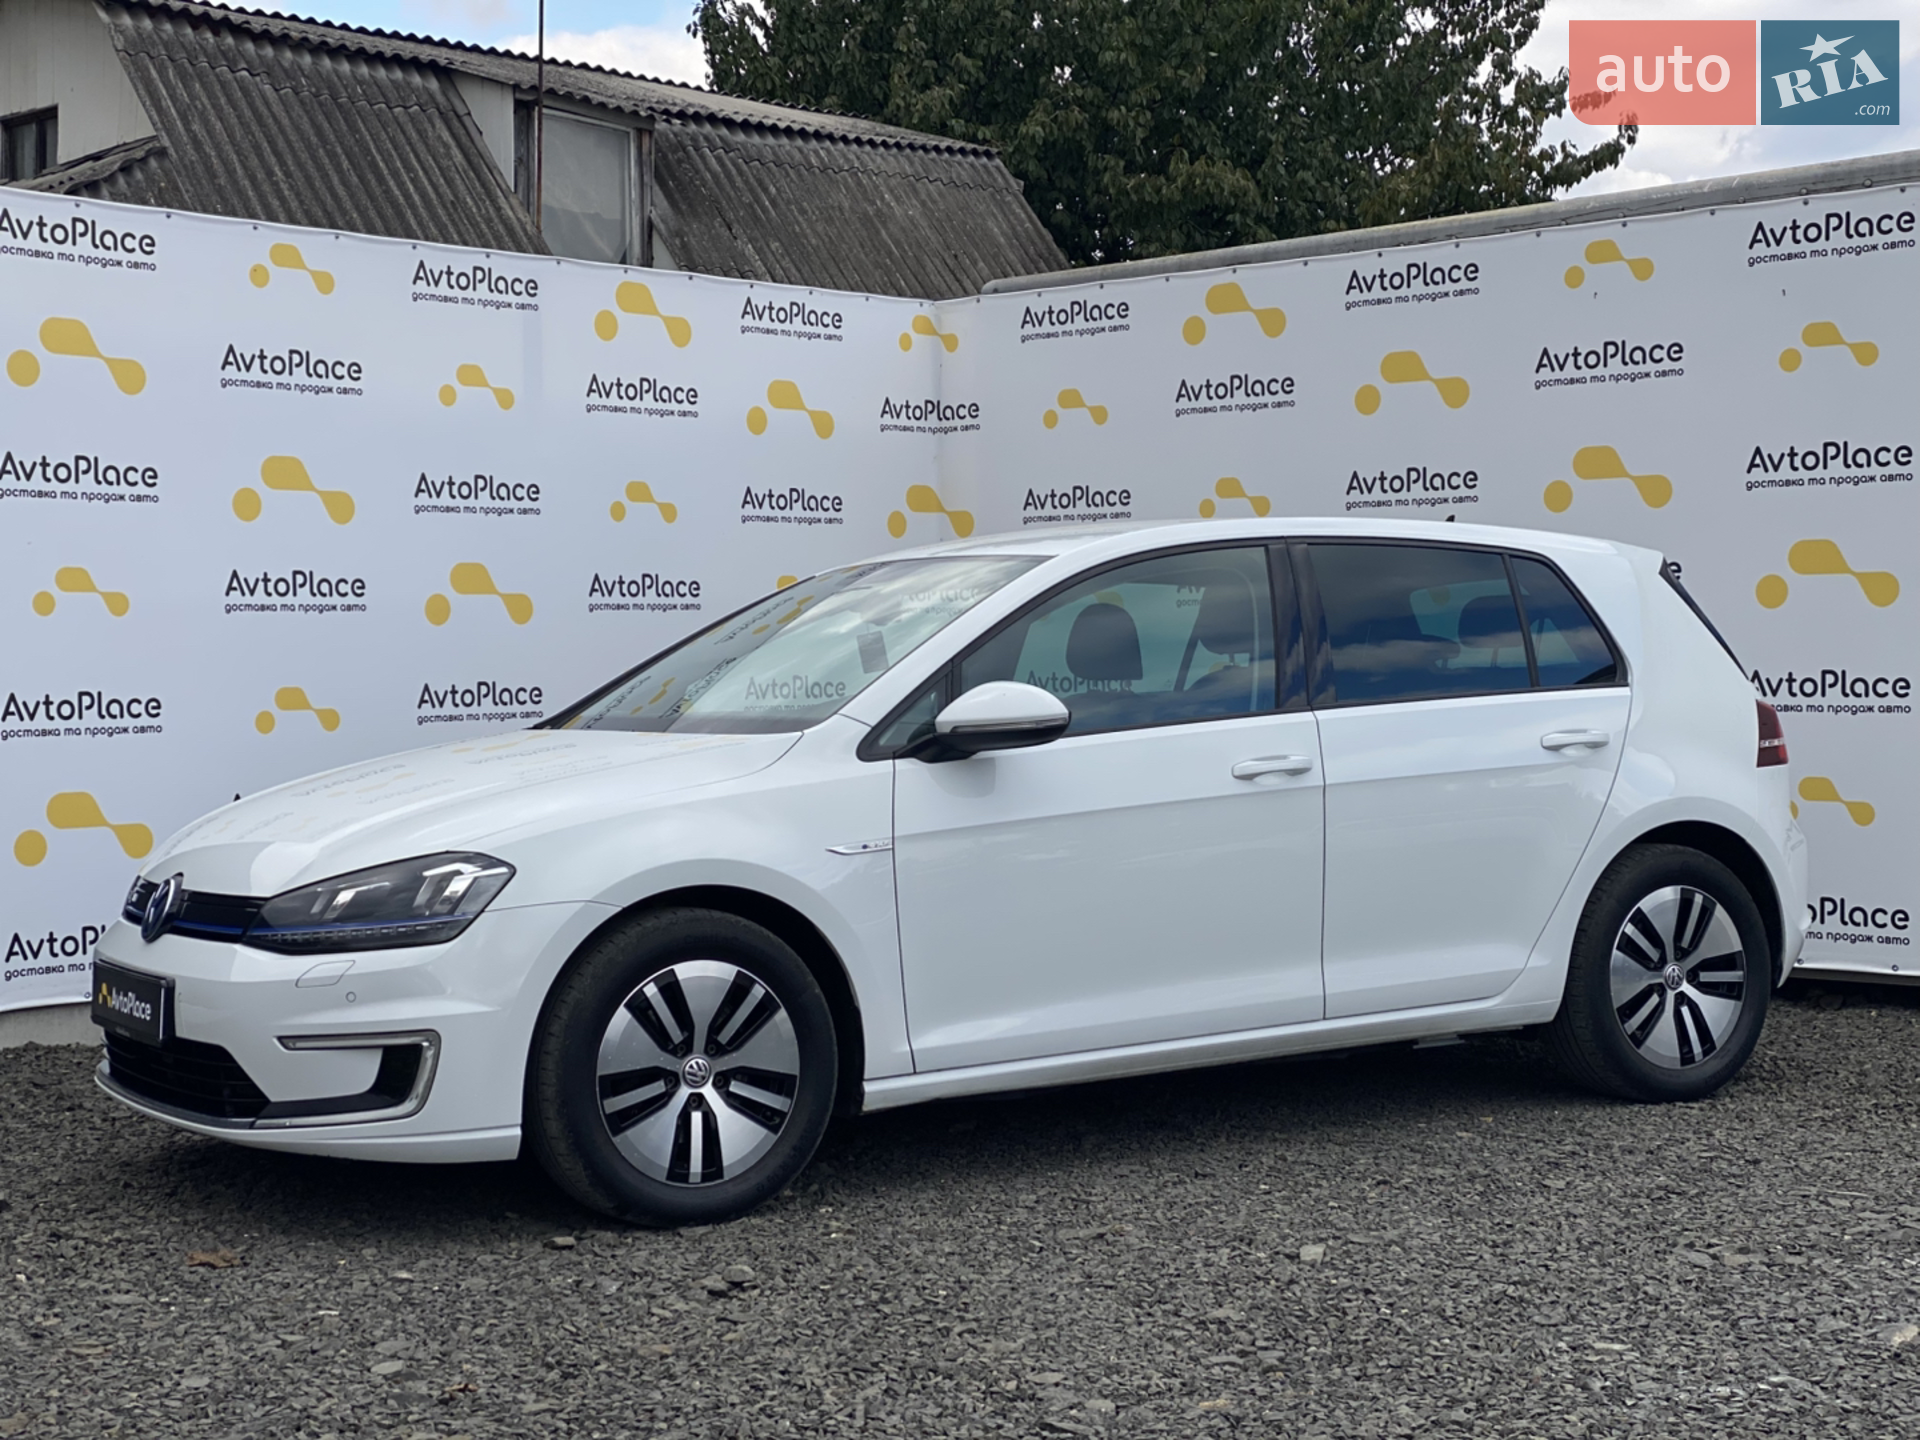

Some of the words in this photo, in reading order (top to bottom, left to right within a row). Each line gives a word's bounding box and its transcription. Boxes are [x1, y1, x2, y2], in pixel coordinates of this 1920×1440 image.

[0, 208, 156, 256] AvtoPlace
[1748, 211, 1915, 250] AvtoPlace
[0, 245, 54, 260] оставка
[57, 252, 75, 262] та
[78, 254, 123, 268] продаж
[126, 260, 156, 271] авто
[1748, 251, 1807, 267] доставка
[1810, 249, 1828, 258] та
[1831, 244, 1879, 258] продаж
[1882, 239, 1916, 250] авто
[412, 260, 538, 298] AvtoPlace
[1345, 261, 1479, 296] AvtoPlace
[412, 292, 459, 304] доставка
[461, 297, 475, 306] та
[477, 298, 512, 310] продаж
[515, 302, 539, 311] авто
[741, 296, 843, 330] AvtoPlace
[1345, 297, 1392, 311] доставка
[1412, 291, 1450, 303] продаж
[1452, 288, 1480, 297] авто
[1021, 300, 1130, 329] AvtoPlace
[221, 344, 362, 382] AvtoPlace
[1535, 340, 1684, 374] AvtoPlace
[220, 378, 274, 390] доставка
[276, 382, 292, 391] та
[294, 384, 334, 395] продаж
[336, 386, 363, 396] авто
[586, 373, 698, 406] AvtoPlace
[1176, 374, 1295, 403] AvtoPlace
[1534, 376, 1587, 390] доставка
[1590, 375, 1606, 383] та
[1609, 371, 1651, 384] продаж
[1654, 368, 1684, 378] авто
[880, 397, 980, 422] AvtoPlace
[0, 451, 158, 488] AvtoPlace
[1746, 440, 1913, 474] AvtoPlace
[414, 472, 540, 502] AvtoPlace
[1346, 466, 1478, 496] AvtoPlace
[1746, 478, 1804, 491] доставка
[1808, 477, 1826, 486] та
[1829, 475, 1876, 487] продаж
[1880, 473, 1913, 482] авто
[60, 491, 78, 500] та
[81, 492, 126, 504] продаж
[128, 494, 159, 503] авто
[414, 505, 461, 515] доставка
[463, 506, 477, 514] та
[479, 506, 514, 516] продаж
[741, 486, 843, 512] AvtoPlace
[1023, 485, 1131, 511] AvtoPlace
[1345, 500, 1392, 511] доставка
[1412, 497, 1449, 508] продаж
[1452, 495, 1478, 504] авто
[225, 569, 366, 598] AvtoPlace
[589, 573, 700, 598] AvtoPlace
[224, 604, 278, 614] доставка
[280, 604, 296, 612] та
[298, 604, 338, 614] продаж
[340, 604, 367, 612] авто
[417, 681, 543, 710] AvtoPlace
[744, 674, 846, 700] AvtoPlace
[1751, 669, 1911, 698] AvtoPlace
[1, 690, 162, 722] AvtoPlace
[417, 714, 464, 726] доставка
[482, 712, 517, 722] продаж
[519, 711, 544, 719] авто
[1806, 704, 1824, 712] та
[1827, 705, 1875, 716] продаж
[1878, 705, 1911, 714] авто
[1, 728, 61, 741] доставка
[64, 728, 82, 736] та
[84, 726, 130, 738] продаж
[132, 725, 162, 734] авто
[4, 925, 106, 963] AvtoP
[1805, 931, 1823, 940] та
[1826, 932, 1874, 944] продаж
[1876, 936, 1910, 946] авто
[4, 965, 65, 982] доставка
[68, 963, 86, 972] та
[112, 987, 151, 1021] AvtoPlace
